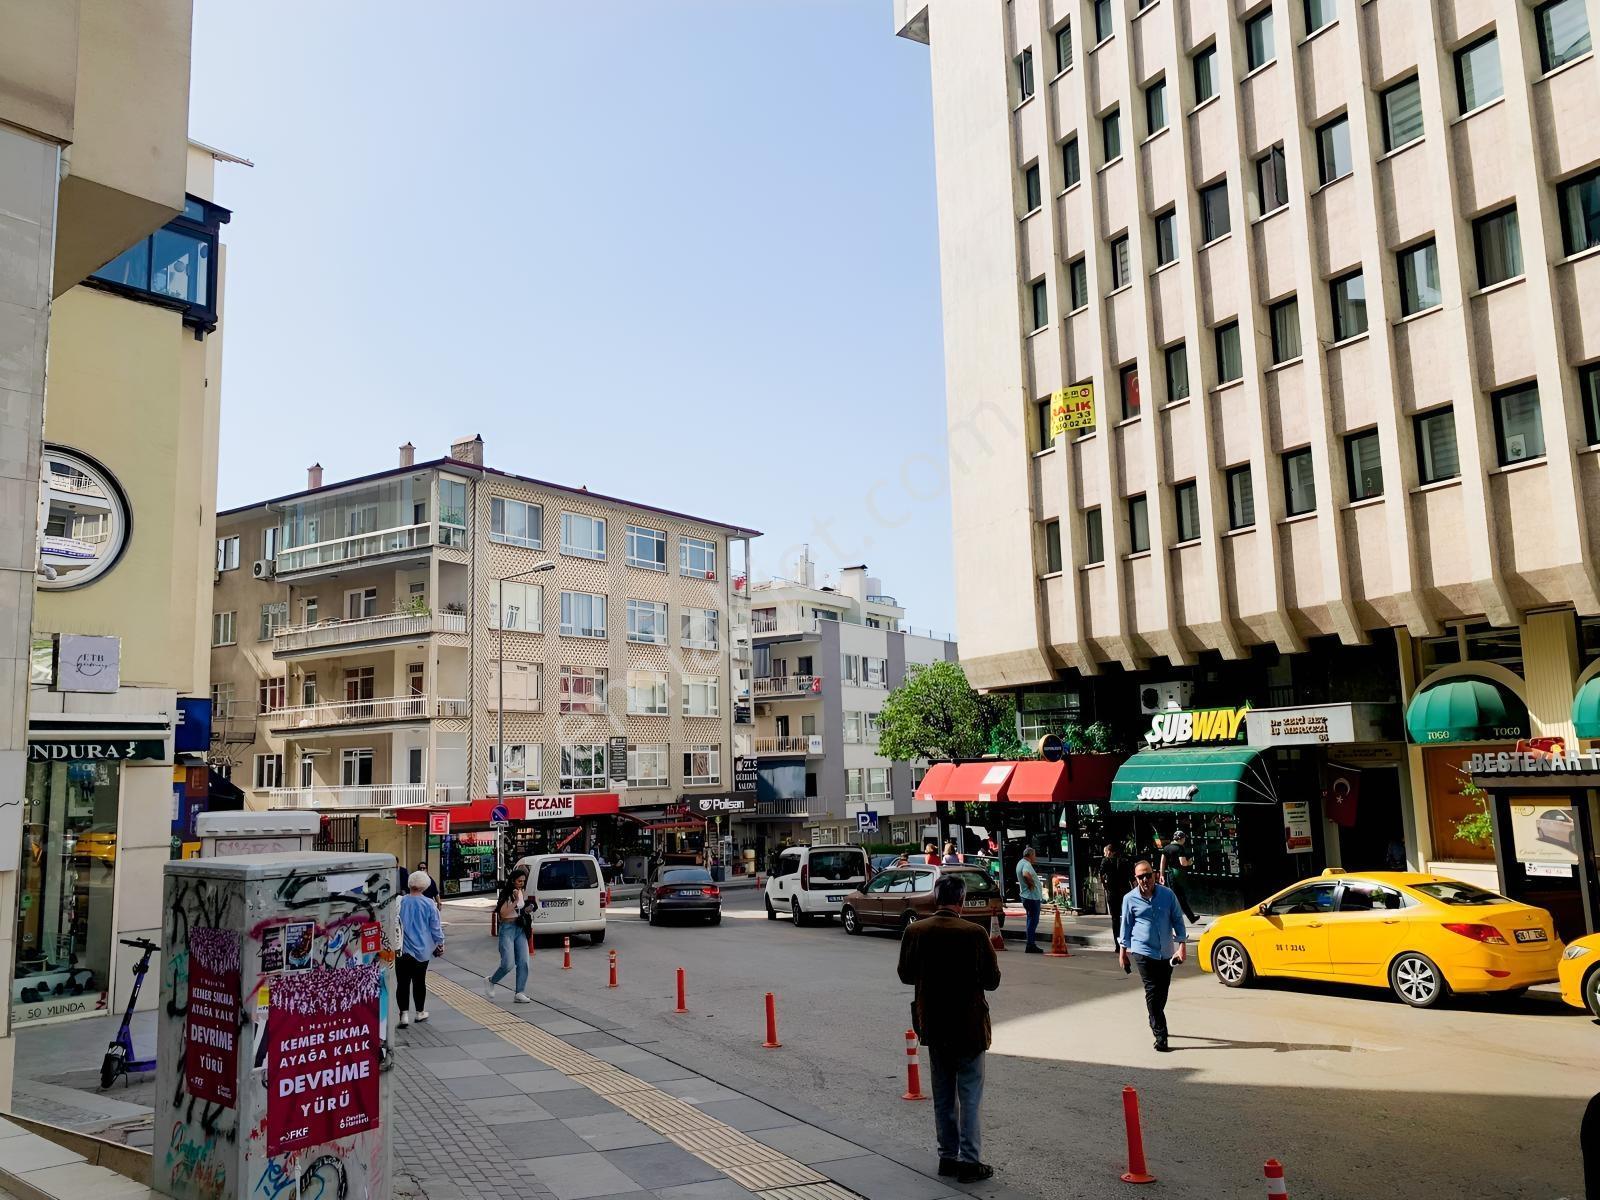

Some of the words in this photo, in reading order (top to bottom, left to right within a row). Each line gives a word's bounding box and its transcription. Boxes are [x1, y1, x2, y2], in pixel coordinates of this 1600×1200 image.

[1144, 705, 1249, 745] SUBWAY
[1284, 723, 1328, 734] MERKEZİ
[1493, 727, 1521, 736] TOGO
[1427, 731, 1450, 740] TOGO
[1137, 784, 1198, 800] SUBWAY
[529, 797, 572, 810] ECZANE
[713, 798, 745, 810] Polisan
[192, 987, 212, 1001] KEMER
[213, 991, 234, 1006] SIKMA
[28, 1008, 42, 1019] 50
[47, 1002, 85, 1015] YILINDA
[191, 1003, 213, 1017] AYAĞA
[215, 1008, 234, 1022] KALK
[191, 1024, 233, 1051] DEVRİME
[280, 1033, 325, 1052] KEMER
[328, 1024, 370, 1042] SIKMA
[200, 1053, 223, 1074] YÜRÜ
[280, 1049, 327, 1068] AYAĞA
[333, 1040, 370, 1057] KALK
[279, 1060, 370, 1097] DEVRİME
[301, 1090, 350, 1117] YÜRÜ
[290, 1127, 309, 1139] FKF
